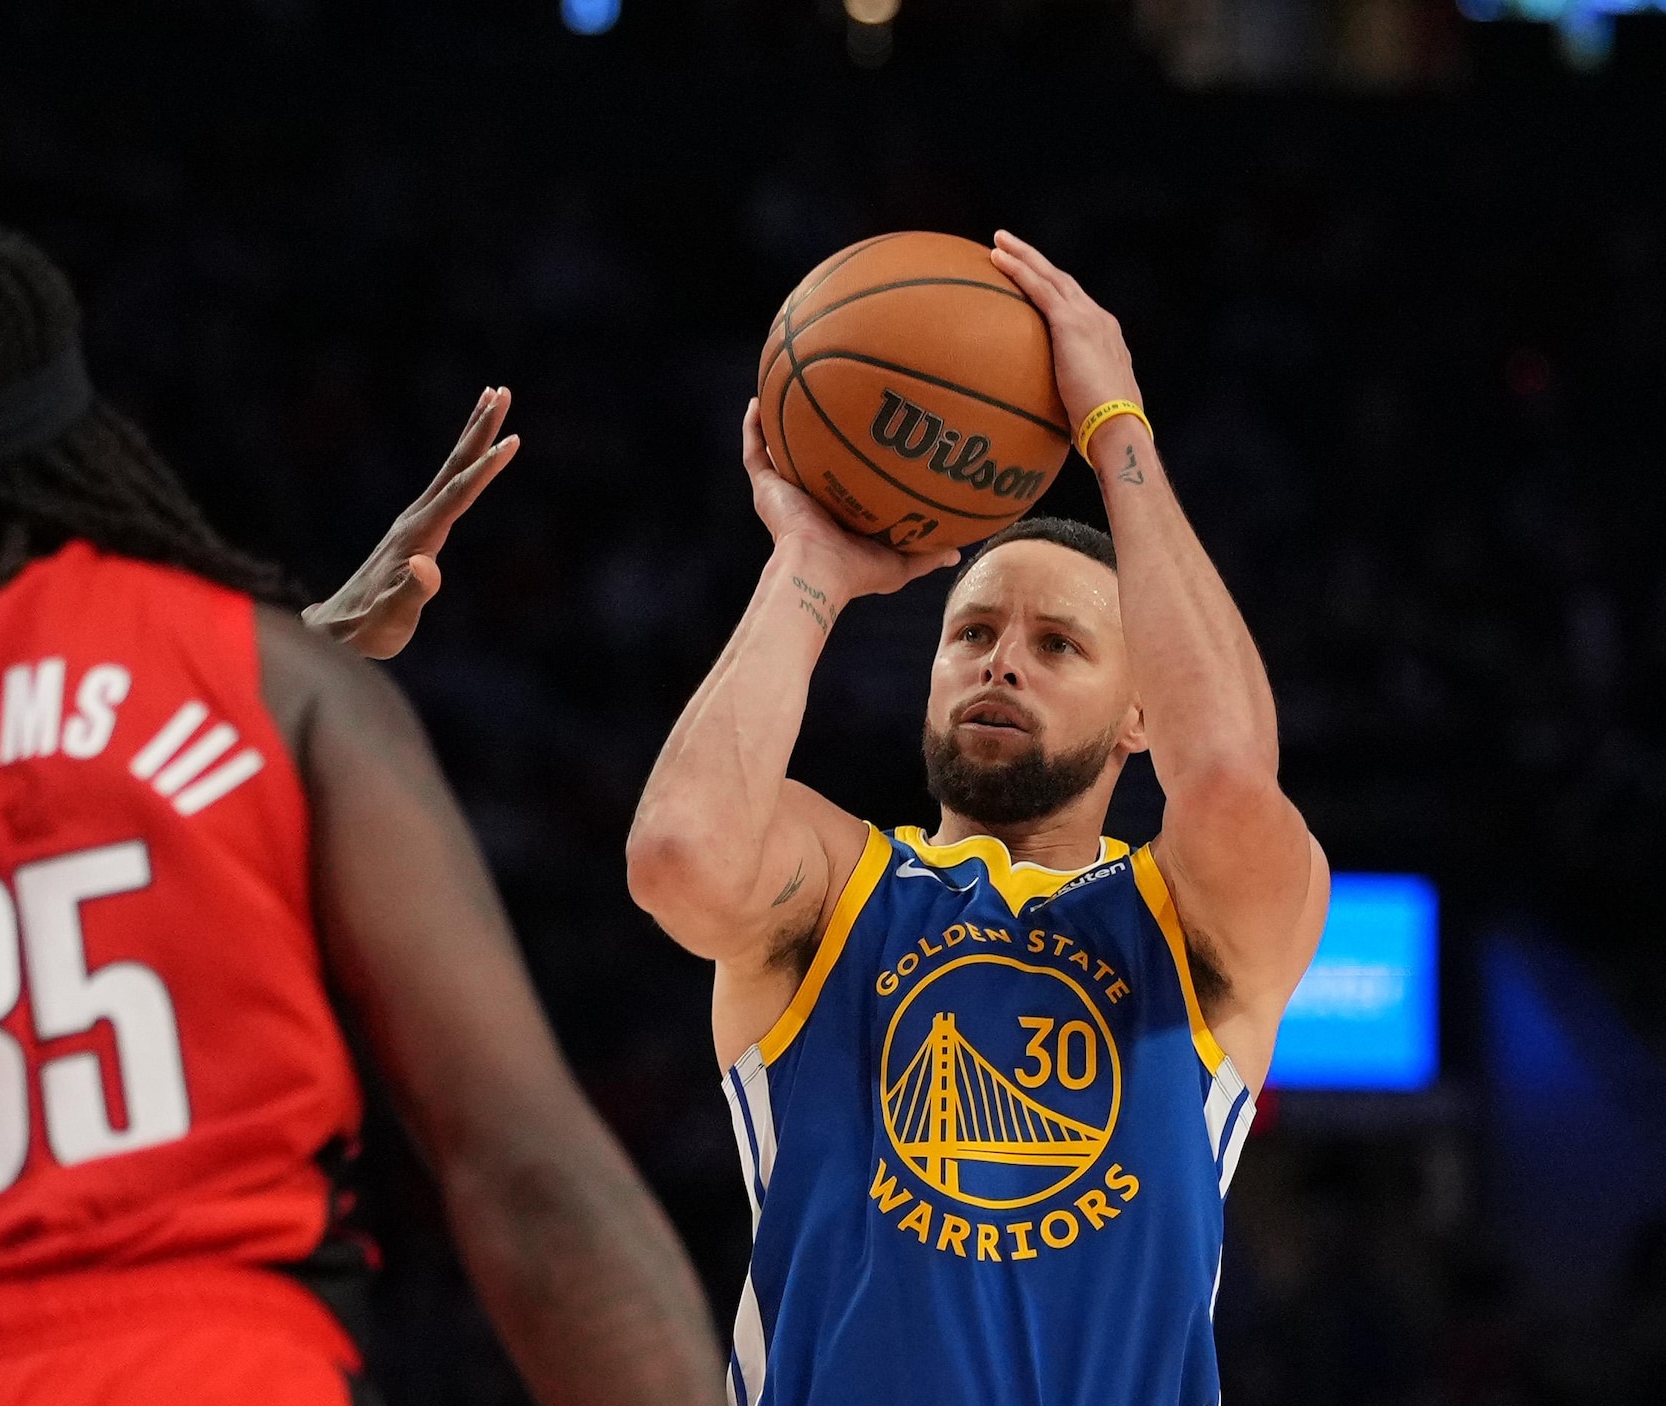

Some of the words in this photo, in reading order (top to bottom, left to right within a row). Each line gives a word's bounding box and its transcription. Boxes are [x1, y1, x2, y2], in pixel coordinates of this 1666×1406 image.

[869, 386, 1047, 500] Wilson
[129, 699, 265, 819] III
[1029, 861, 1128, 913] kuten
[875, 921, 1014, 998] GOLDEN
[1026, 929, 1132, 1005] STATE
[1013, 1015, 1098, 1091] 30
[868, 1157, 1141, 1264] WARRIORS
